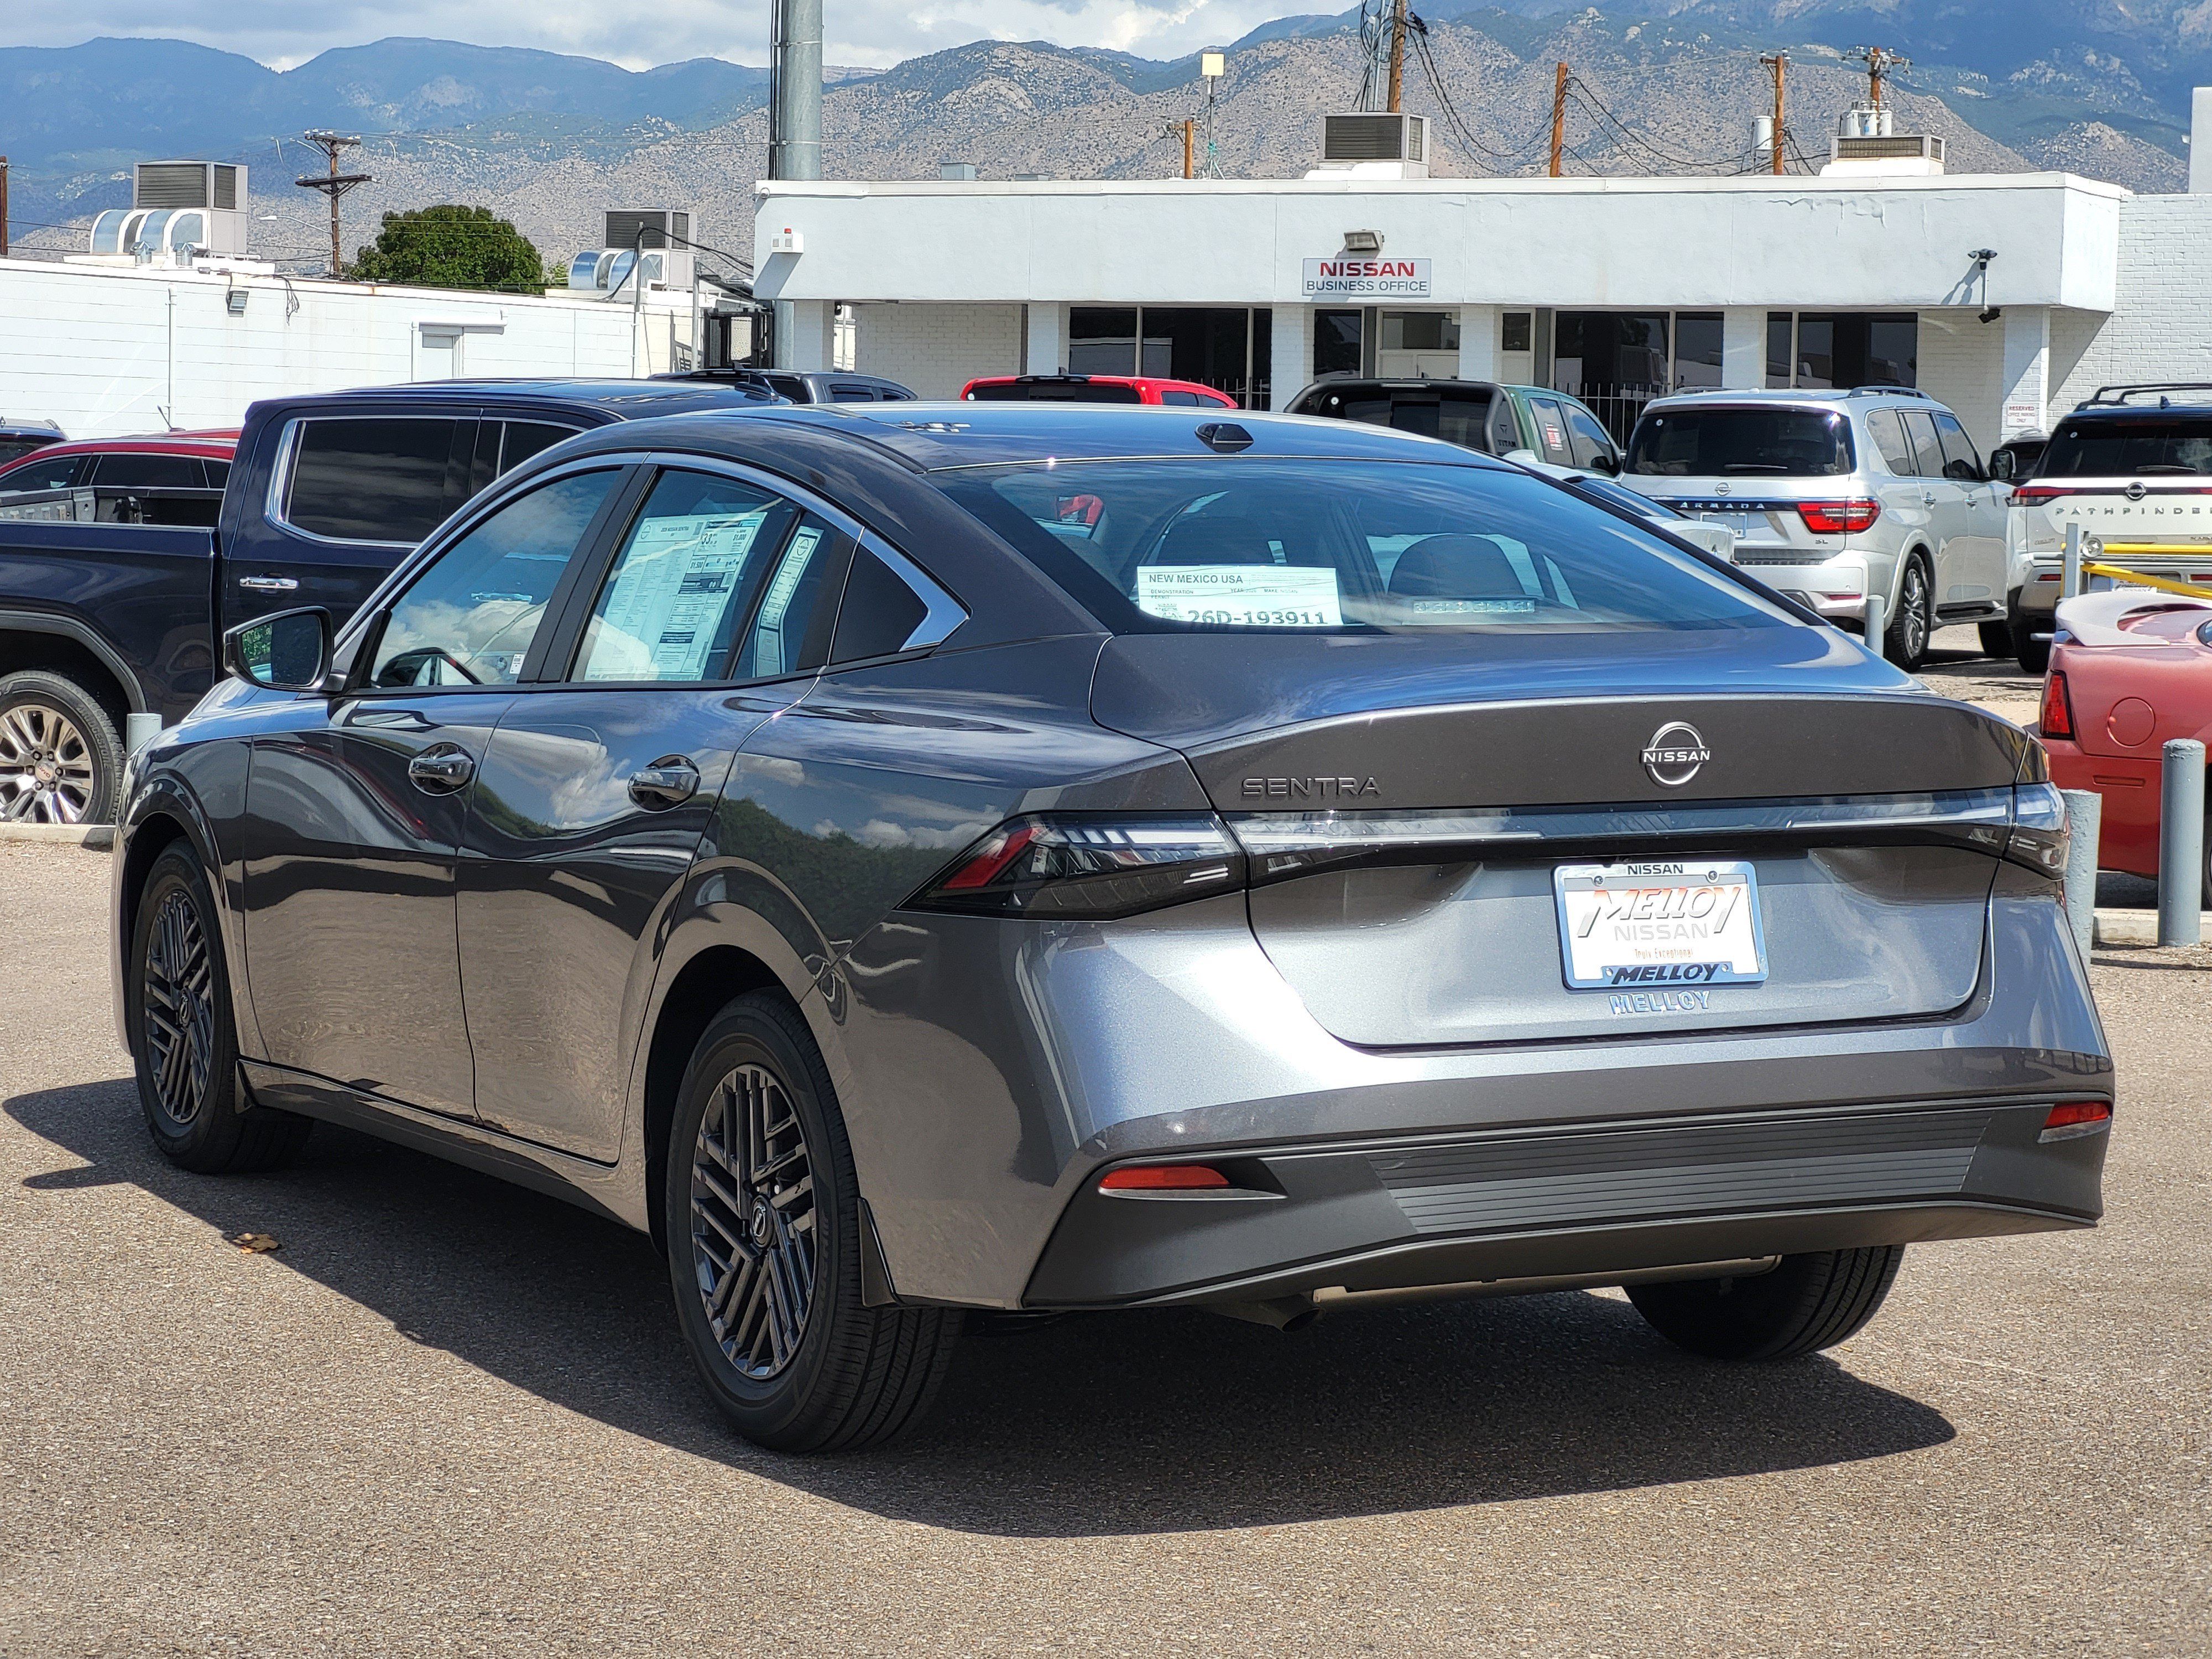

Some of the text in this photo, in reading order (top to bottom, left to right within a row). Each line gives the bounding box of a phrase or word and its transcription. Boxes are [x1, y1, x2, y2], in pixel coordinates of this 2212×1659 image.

[1320, 262, 1414, 276] NISSAN
[1307, 280, 1427, 291] BUSINESS OFFICE
[1149, 574, 1174, 582] NEW
[1177, 575, 1218, 583] MEXICO
[1221, 575, 1243, 583] USA
[1188, 610, 1328, 624] 26D-193911
[1643, 750, 1710, 763] NISSAN
[1242, 778, 1381, 796] SENTRA
[1627, 864, 1683, 874] NISSAN
[1577, 887, 1741, 937] MELLOY
[1614, 923, 1708, 941] NISSAN
[1635, 948, 1693, 959] Truly Exceptional
[1611, 963, 1719, 985] MELLOY
[1610, 990, 1710, 1015] MELLOY
